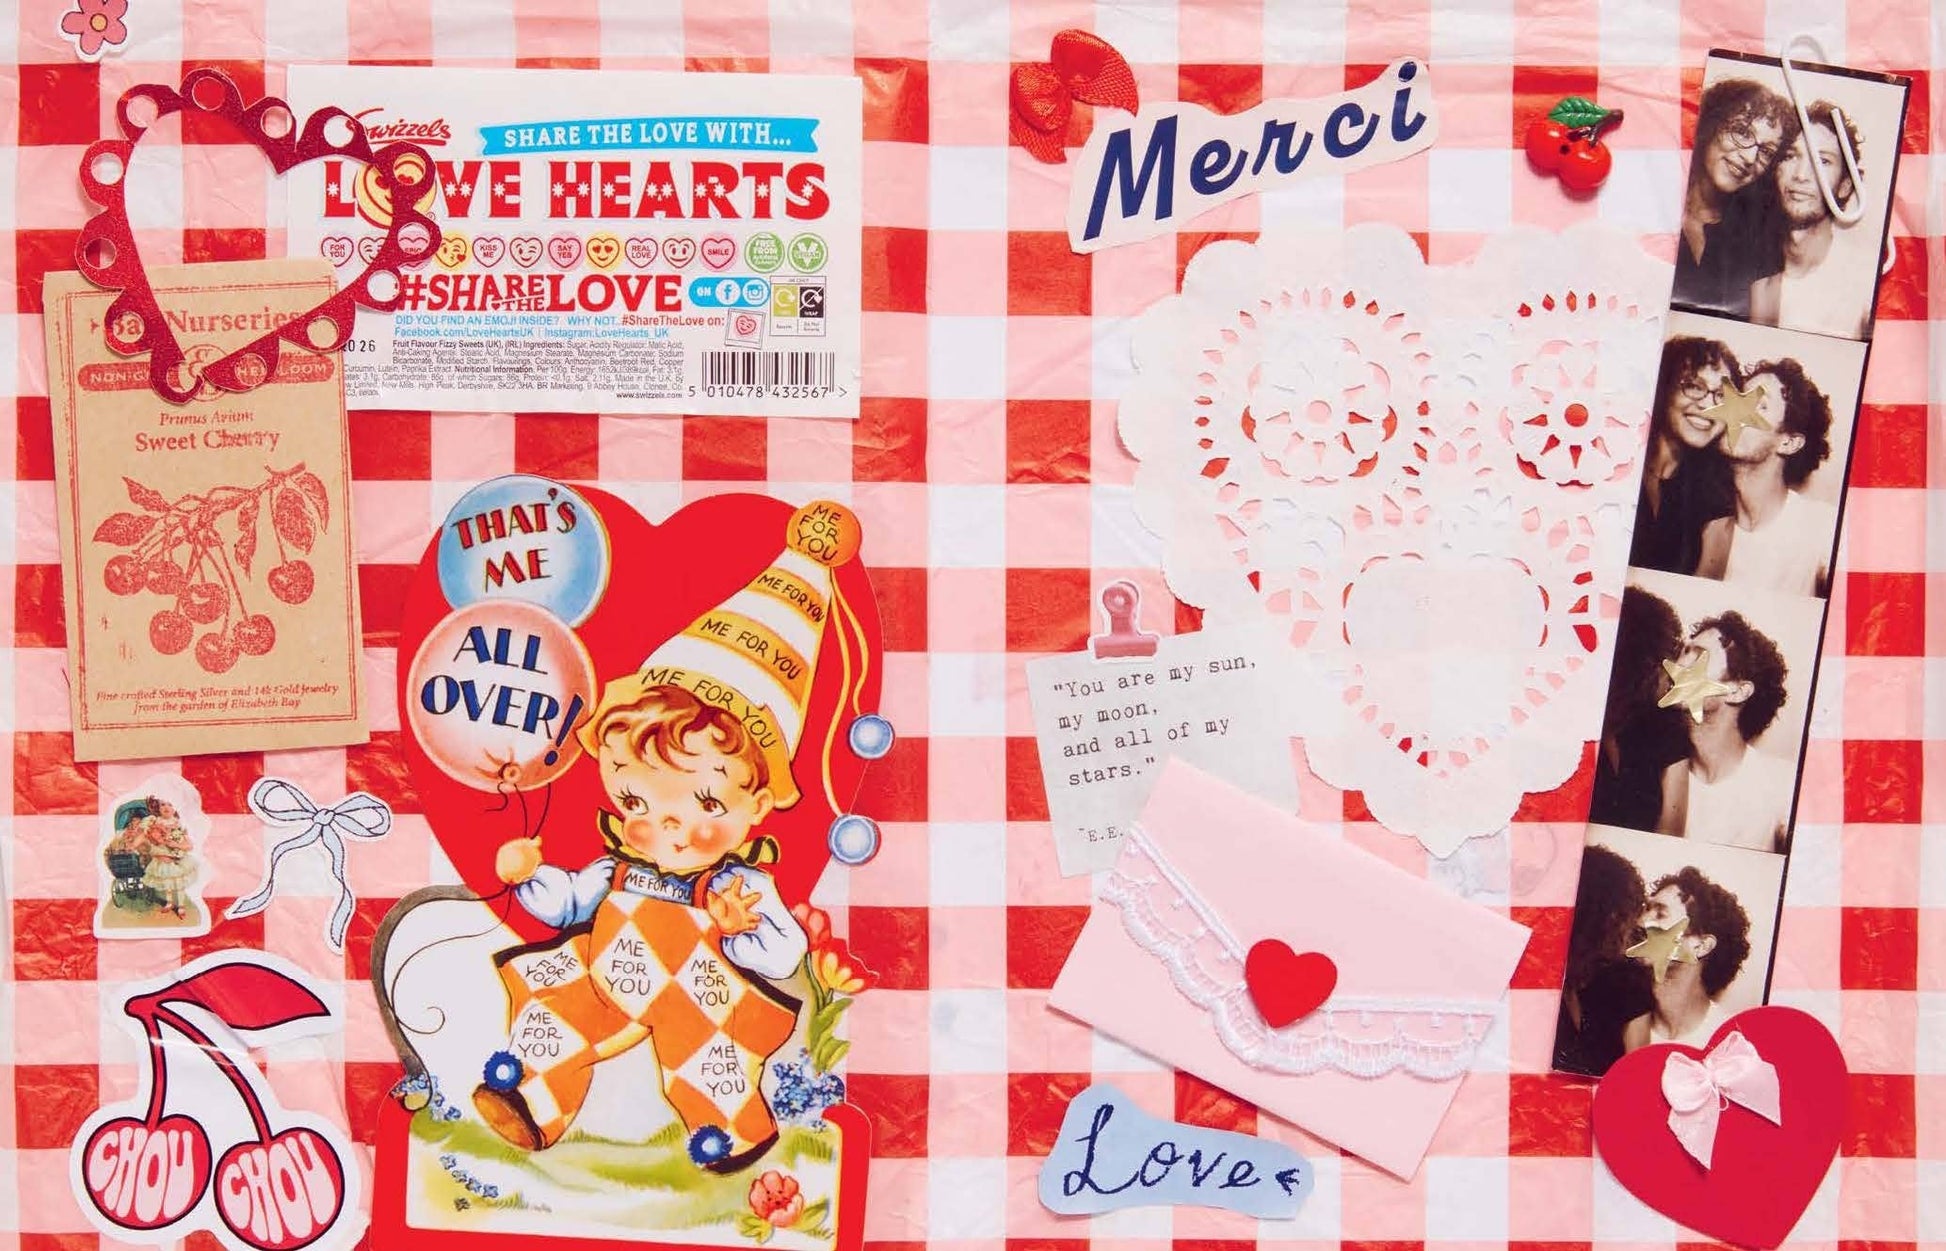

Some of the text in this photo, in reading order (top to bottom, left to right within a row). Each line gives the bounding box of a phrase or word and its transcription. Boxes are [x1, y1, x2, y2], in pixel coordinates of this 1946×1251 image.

[505, 122, 791, 147] SHARE THE LOVE WITH...
[1082, 61, 1427, 241] Merci
[549, 161, 830, 220] HEARTS
[330, 250, 346, 258] YOU
[707, 248, 729, 256] SMILE
[396, 315, 413, 325] DID
[416, 315, 438, 325] YOU
[441, 315, 464, 325] FIND
[467, 315, 482, 325] AN
[485, 315, 516, 326] EMOJI
[519, 315, 559, 326] INSIDE?
[568, 315, 591, 325] WHY
[622, 315, 704, 326] #ShareTheLove
[707, 316, 724, 326] on:
[360, 339, 376, 352] 26
[392, 339, 409, 348] Fruit
[411, 339, 437, 348] Flavour
[439, 339, 457, 349] Fizzy
[459, 340, 483, 348] Sweets
[688, 386, 696, 397] 5
[707, 386, 764, 398] 010478
[772, 386, 829, 398] 432567
[160, 411, 207, 425] Prunus
[135, 429, 280, 452] Sweet Cherry
[450, 488, 578, 550] THAT'S
[813, 504, 842, 527] ME
[800, 514, 840, 544] FOR
[796, 529, 838, 562] YOU
[485, 548, 552, 593] ME
[757, 573, 826, 623] ME FOR YOU
[453, 625, 549, 676] ALL
[700, 618, 801, 680] ME FOR YOU
[1118, 672, 1155, 689] are
[1168, 664, 1193, 683] my
[1208, 655, 1256, 674] sun,
[199, 687, 228, 698] Silver
[231, 686, 251, 696] and
[162, 702, 178, 711] the
[178, 701, 215, 714] garden
[217, 699, 229, 712] of
[641, 668, 777, 750] ME FOR YOU
[1058, 702, 1158, 731] my moon,
[421, 674, 585, 767] OVER!
[1063, 716, 1229, 758] and all of my
[625, 872, 691, 900] ME FOR YOU
[614, 938, 644, 957] ME
[536, 958, 567, 981] FOR
[553, 951, 577, 970] ME
[611, 959, 647, 975] FOR
[690, 959, 717, 973] ME
[525, 965, 556, 987] YOU
[604, 975, 651, 996] YOU
[694, 973, 728, 988] FOR
[693, 990, 730, 1007] YOU
[526, 1012, 552, 1025] ME
[522, 1026, 563, 1040] FOR
[517, 1042, 560, 1058] YOU
[708, 1045, 736, 1059] ME
[700, 1062, 738, 1075] FOR
[706, 1079, 746, 1097] YOU
[1063, 1103, 1261, 1197] Love
[88, 1126, 194, 1222] CHOU
[221, 1132, 336, 1245] CHOU
